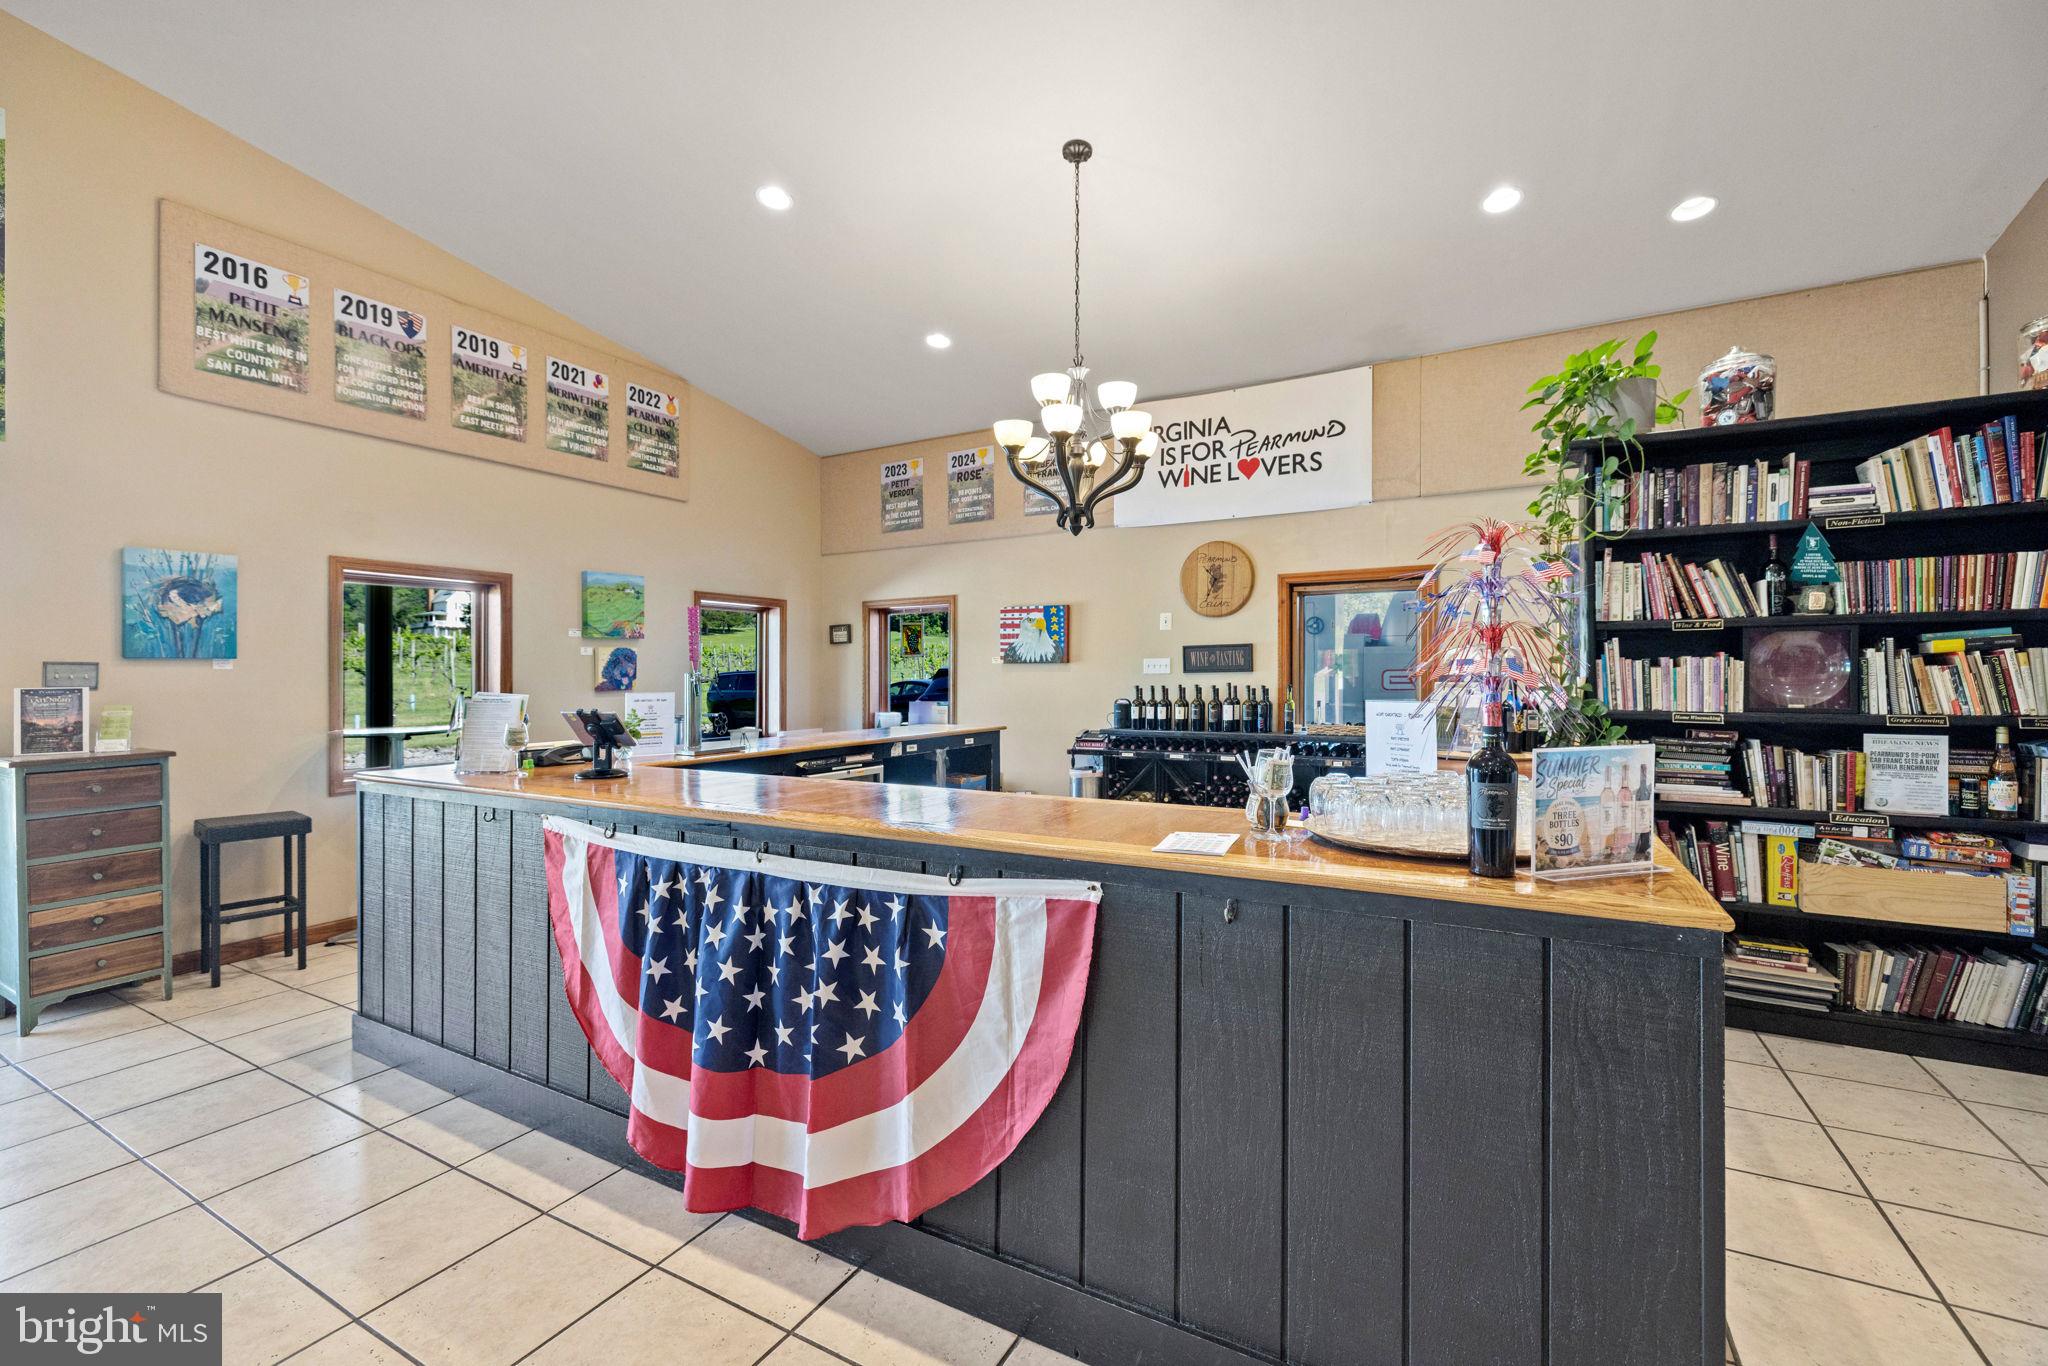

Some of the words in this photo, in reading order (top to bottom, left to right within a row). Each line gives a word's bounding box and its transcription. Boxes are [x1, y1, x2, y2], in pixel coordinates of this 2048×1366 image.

[204, 251, 268, 289] 2016
[230, 292, 279, 316] PETIT
[341, 295, 392, 327] 2019
[209, 307, 299, 342] MANSENG
[196, 326, 228, 341] BEST
[230, 334, 264, 351] WHITE
[267, 343, 294, 358] WINE
[296, 351, 307, 362] IN
[338, 324, 390, 350] BLACK
[394, 340, 425, 358] OPS
[458, 331, 498, 358] 2019
[207, 358, 232, 372] SAN
[226, 348, 280, 368] COUNTRY
[338, 363, 355, 374] FOR
[395, 368, 418, 379] SELLS
[456, 358, 527, 386] AMERITAGE
[552, 361, 586, 386] 2021
[336, 386, 390, 404] FOUNDATION
[392, 398, 425, 413] AUCTION
[376, 384, 387, 392] OF
[389, 387, 424, 402] SUPPORT
[548, 386, 608, 411] MERIWETHER
[630, 386, 660, 410] 2022
[463, 406, 518, 425] INTERNATIONAL
[496, 402, 516, 413] SHOW
[557, 401, 602, 420] VINEYARD
[460, 415, 478, 426] EAST
[481, 419, 504, 432] MEETS
[506, 424, 524, 436] WEST
[628, 407, 676, 428] PEARMUND
[634, 422, 671, 440] CELLARS
[1230, 420, 1346, 460] PEARMUND
[560, 440, 568, 448] IN
[570, 442, 596, 455] VIRGINIA
[1160, 446, 1176, 466] IS
[1180, 440, 1227, 464] FOR
[952, 452, 976, 468] 2024
[885, 464, 907, 478] 2023
[891, 478, 910, 488] PETIT
[889, 488, 915, 498] VERDOT
[1830, 516, 1881, 528] Non-Fiction
[1190, 650, 1209, 668] WINE
[1216, 650, 1245, 666] TASTING
[1890, 716, 1912, 725] Grape
[1536, 756, 1600, 788] SUMMER
[1898, 764, 1938, 772] BENCHMARK
[1546, 774, 1588, 799] Special
[1549, 819, 1580, 829] BOTTLES
[1552, 810, 1577, 820] THREE
[1835, 814, 1885, 824] Education
[1554, 833, 1574, 847] $90
[1715, 842, 1730, 871] Wine
